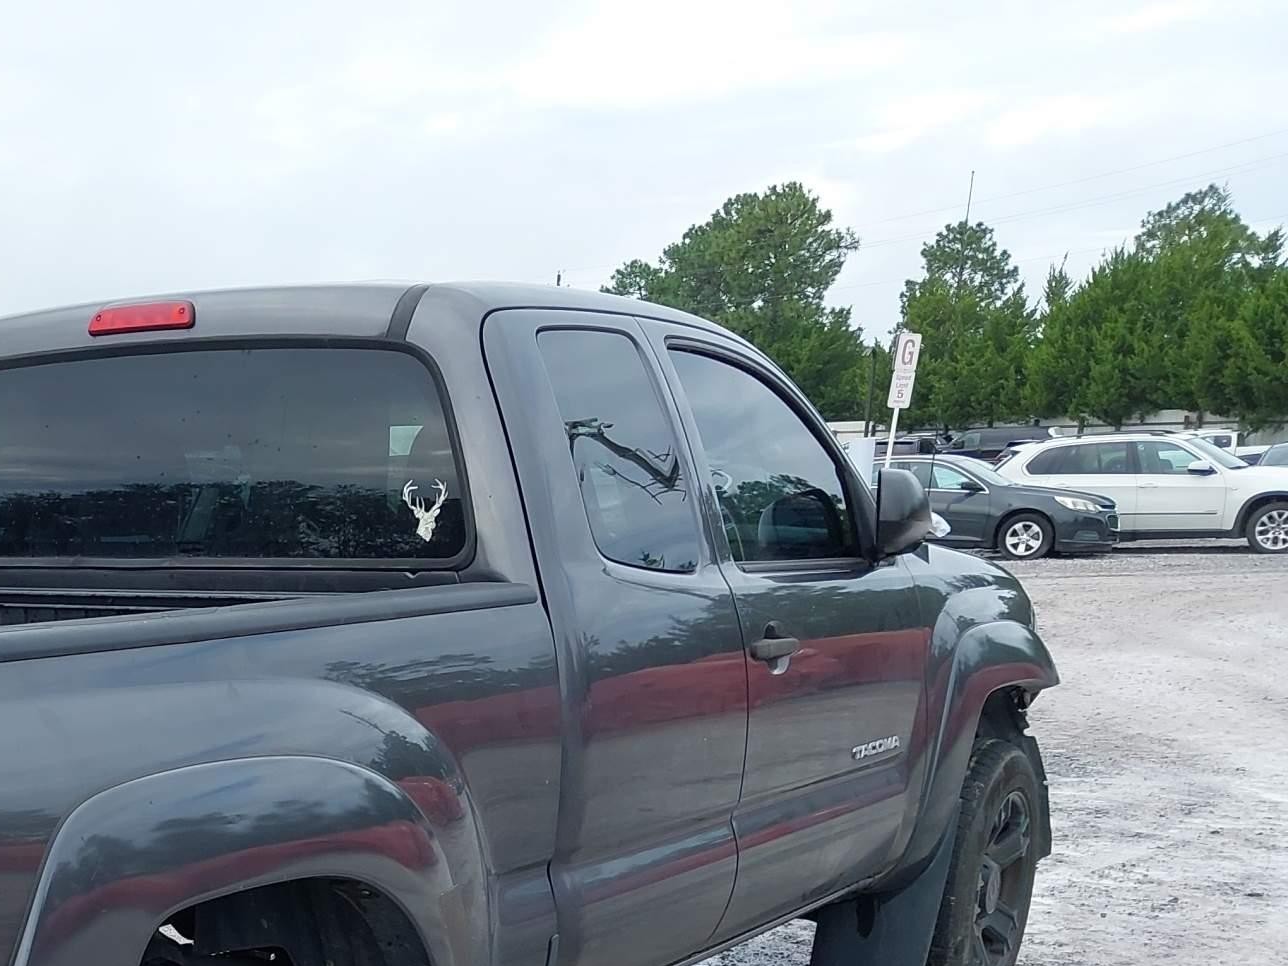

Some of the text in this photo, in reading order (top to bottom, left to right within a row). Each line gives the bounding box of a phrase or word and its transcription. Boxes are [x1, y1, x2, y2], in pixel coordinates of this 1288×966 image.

[902, 339, 916, 365] G
[897, 389, 904, 399] 5
[852, 735, 901, 760] TACOMA
